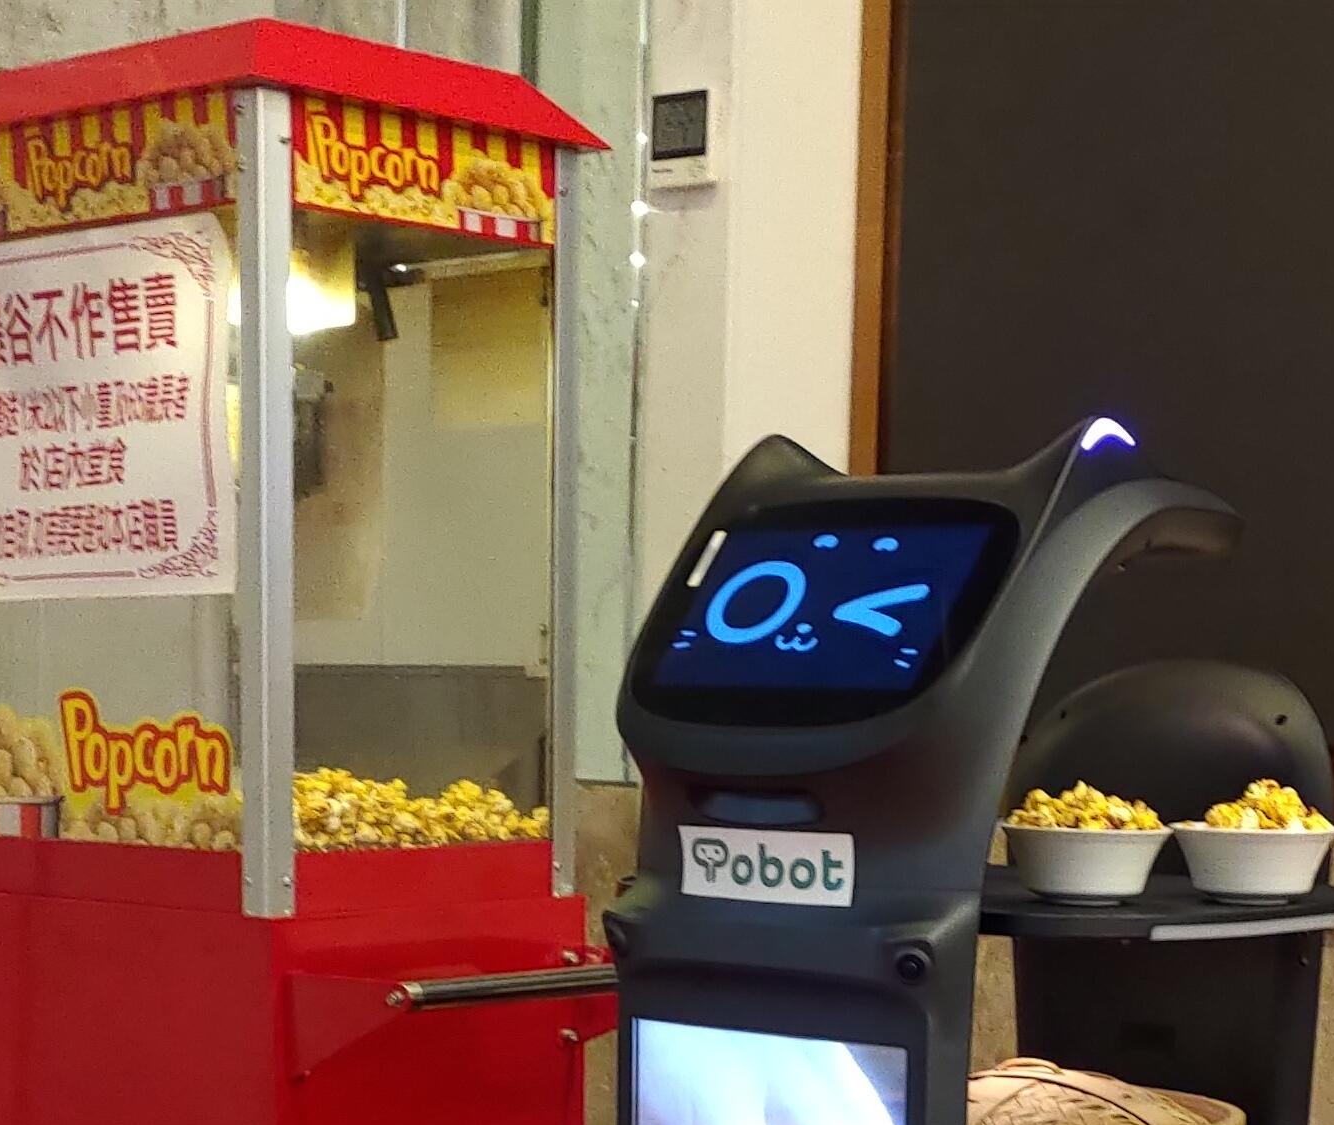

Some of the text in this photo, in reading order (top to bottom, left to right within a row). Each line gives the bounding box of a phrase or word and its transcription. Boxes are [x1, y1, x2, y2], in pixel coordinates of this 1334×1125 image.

[24, 135, 133, 211] Popcorn
[311, 111, 441, 199] Popcorn
[60, 690, 231, 815] Popcorn
